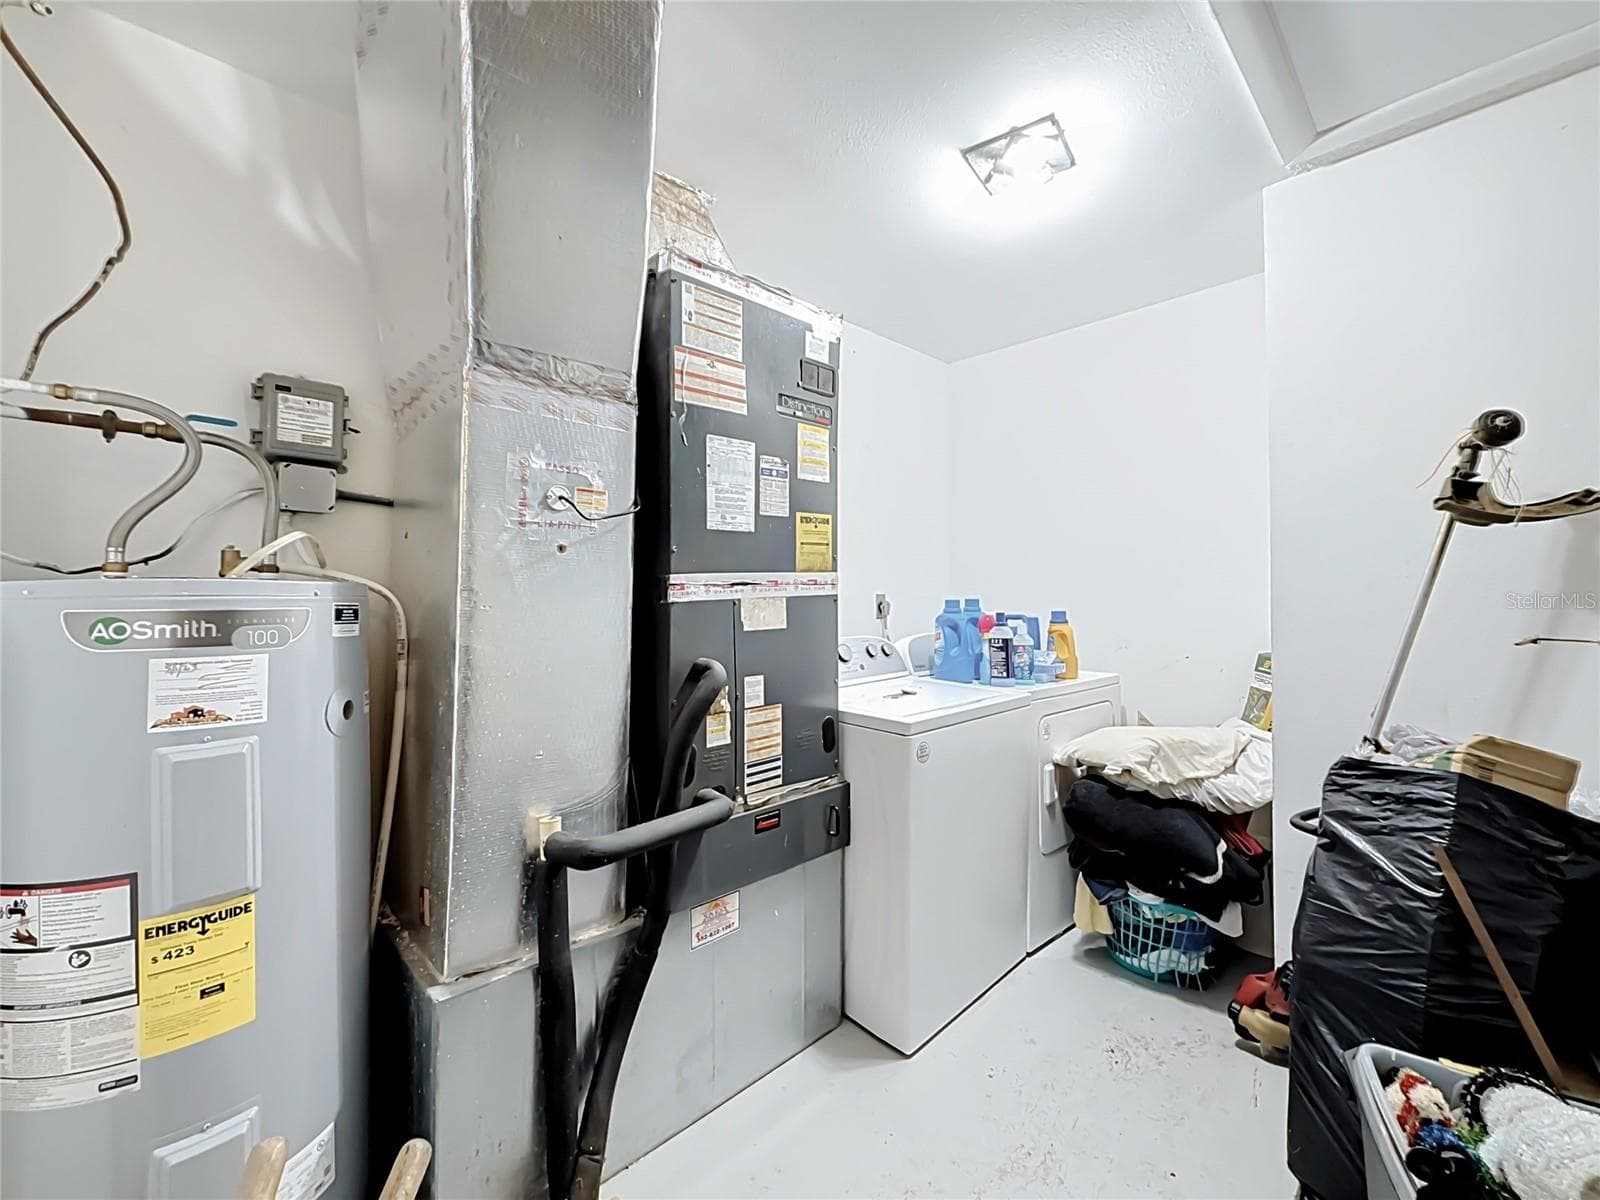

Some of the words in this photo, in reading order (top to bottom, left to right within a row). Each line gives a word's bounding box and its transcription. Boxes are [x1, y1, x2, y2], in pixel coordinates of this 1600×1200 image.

[246, 629, 279, 646] 100
[144, 901, 253, 940] ENERGYGUIDE
[163, 945, 195, 961] 423
